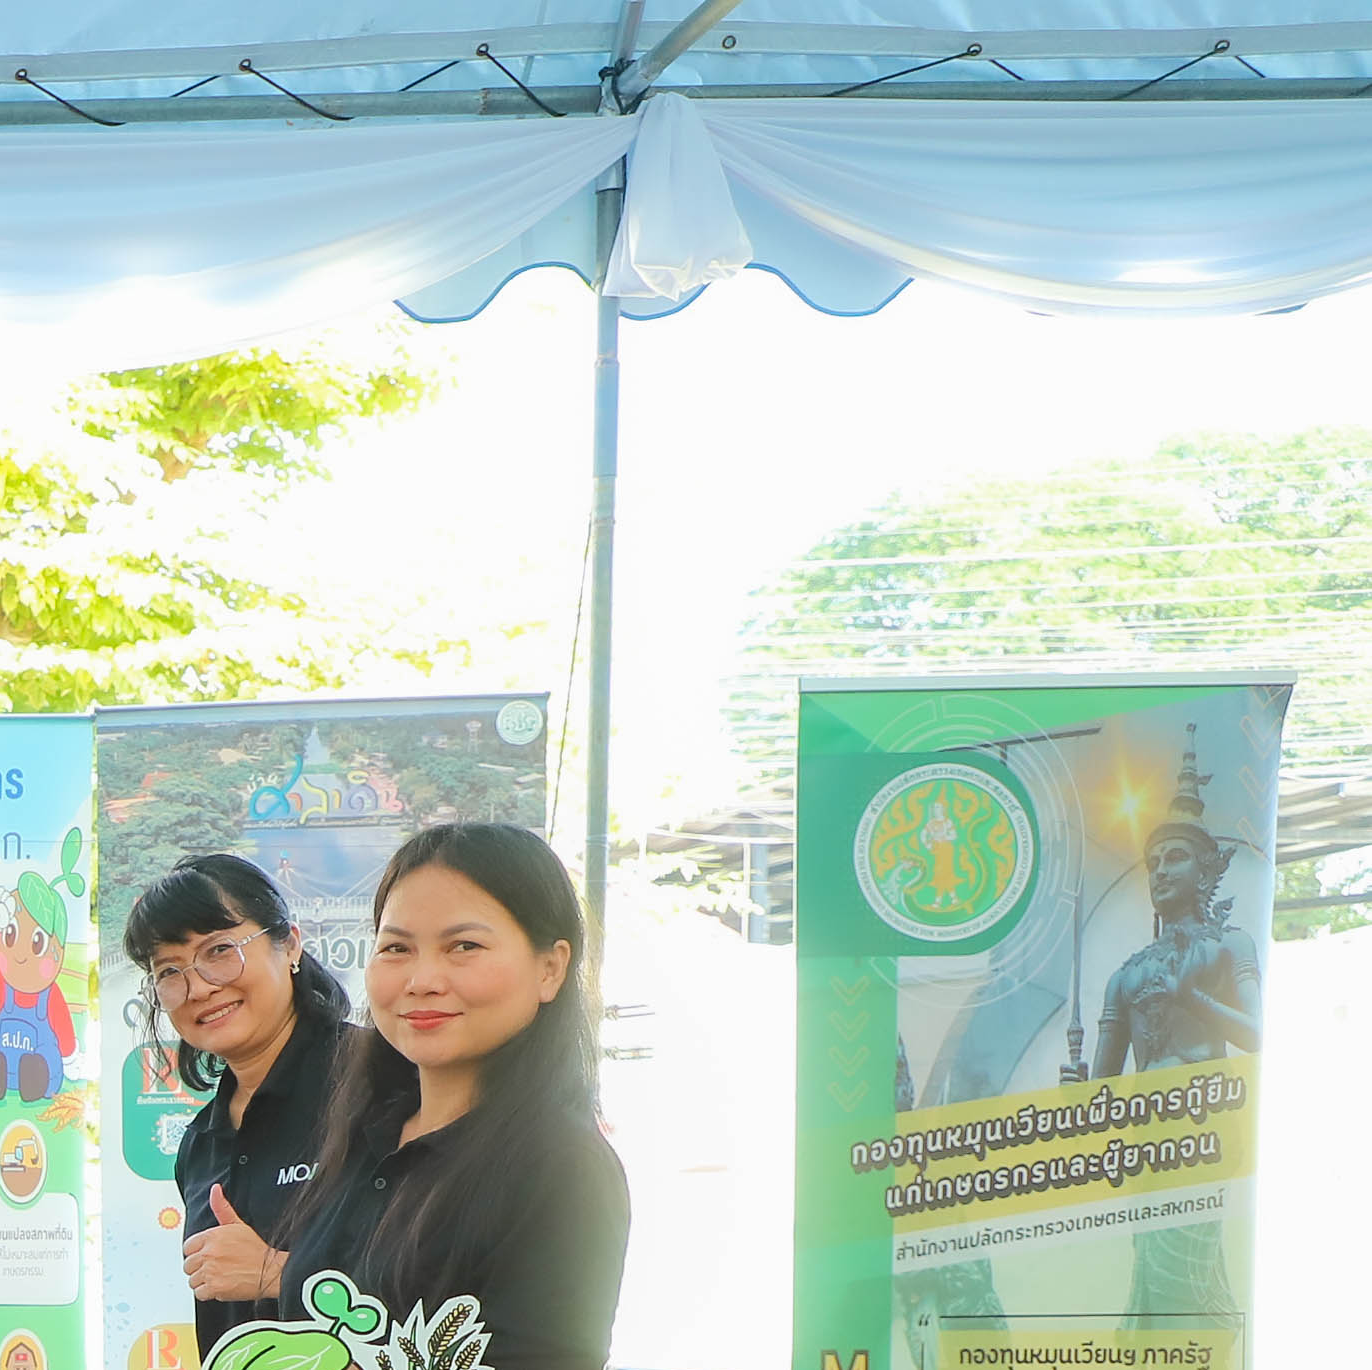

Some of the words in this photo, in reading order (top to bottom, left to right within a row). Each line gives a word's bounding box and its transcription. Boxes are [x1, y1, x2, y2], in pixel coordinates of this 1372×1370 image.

[1, 1030, 34, 1051] ส.ป.ก.
[851, 1074, 1245, 1170] กองทุนหมุนเวียนเพื่อการกู้ยืม
[886, 1131, 1217, 1209] แก่เกษตรกรและผู้ยากจน
[896, 1188, 1224, 1261] สำนักงานปลัดกระทรวงเกษตรและสหกรณ์
[1143, 1341, 1212, 1370] ภาครัฐ
